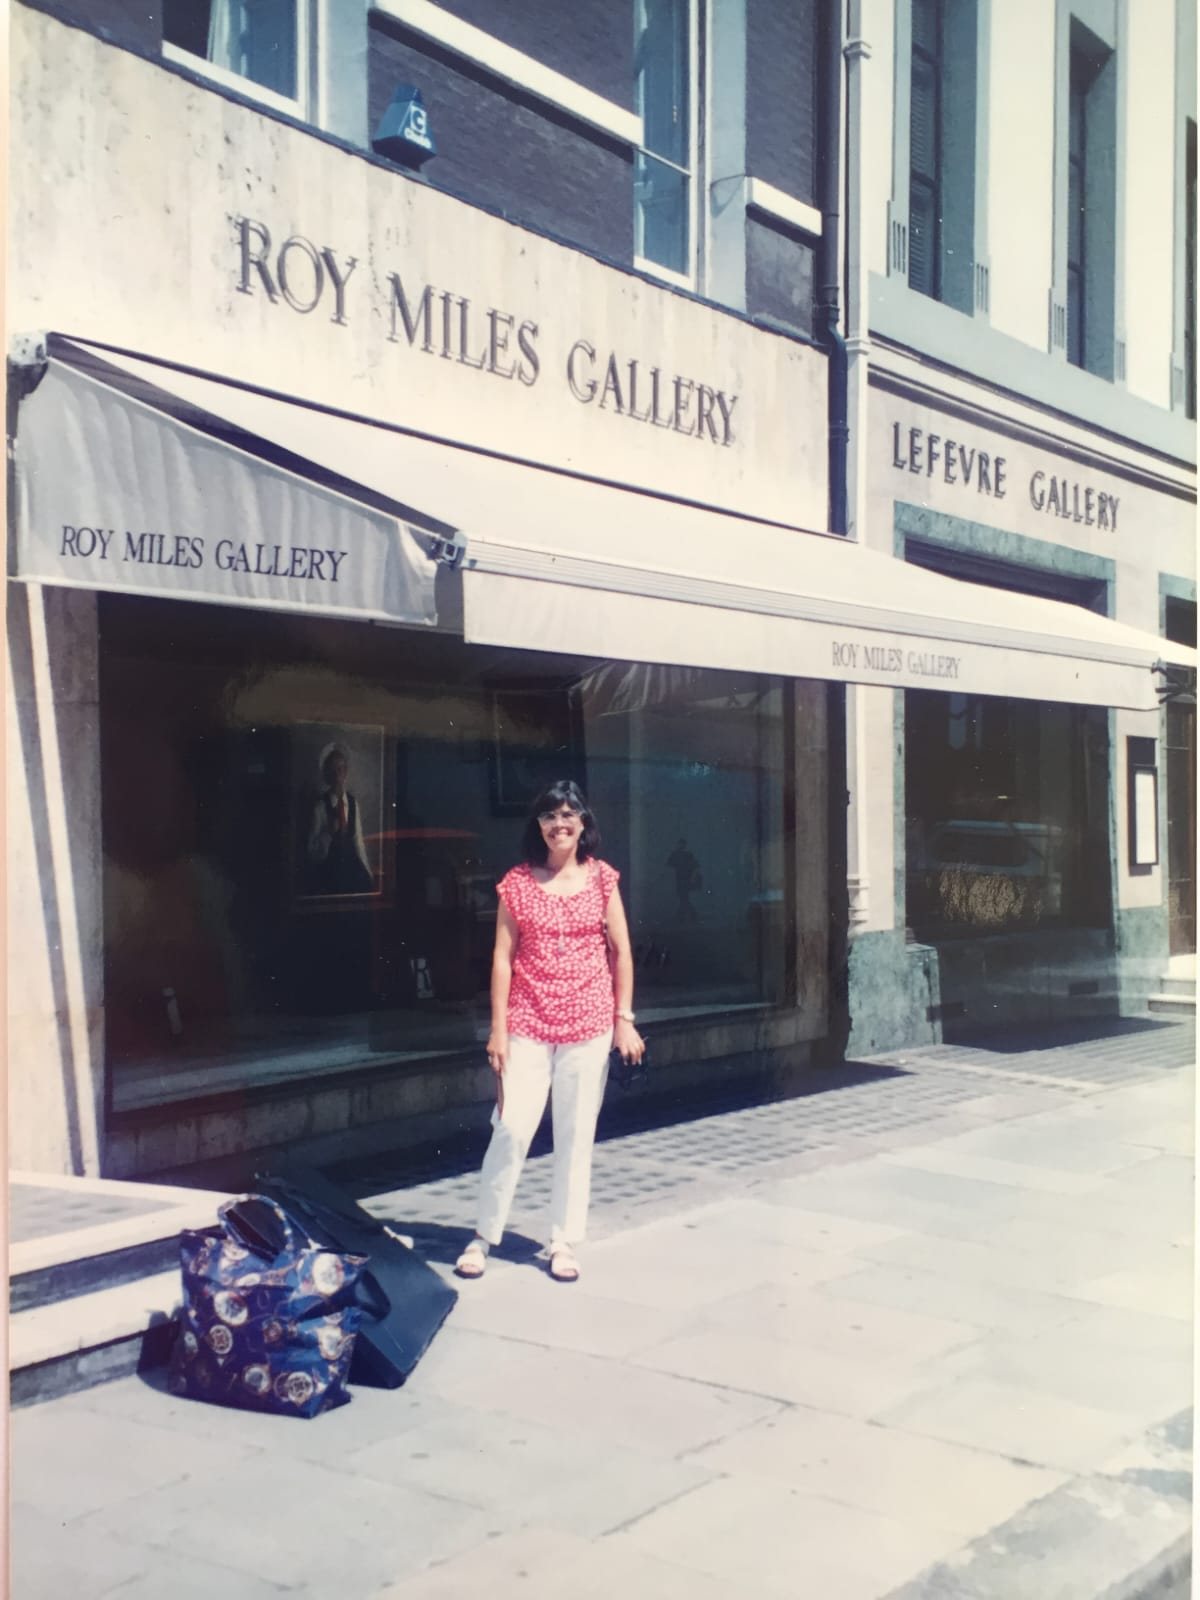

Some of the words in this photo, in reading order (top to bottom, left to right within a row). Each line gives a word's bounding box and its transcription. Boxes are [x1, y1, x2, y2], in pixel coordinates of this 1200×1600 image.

[234, 214, 359, 327] ROY
[386, 270, 541, 387] MILES
[567, 339, 739, 448] GALLERY
[892, 421, 1007, 499] LEFEVRE
[1029, 469, 1120, 534] GALLERY
[60, 525, 115, 560] ROY
[122, 531, 204, 568] MILES
[214, 538, 348, 582] GALLERY
[832, 641, 861, 668] ROY
[863, 646, 903, 673] MILES
[907, 651, 963, 679] GALLERY
